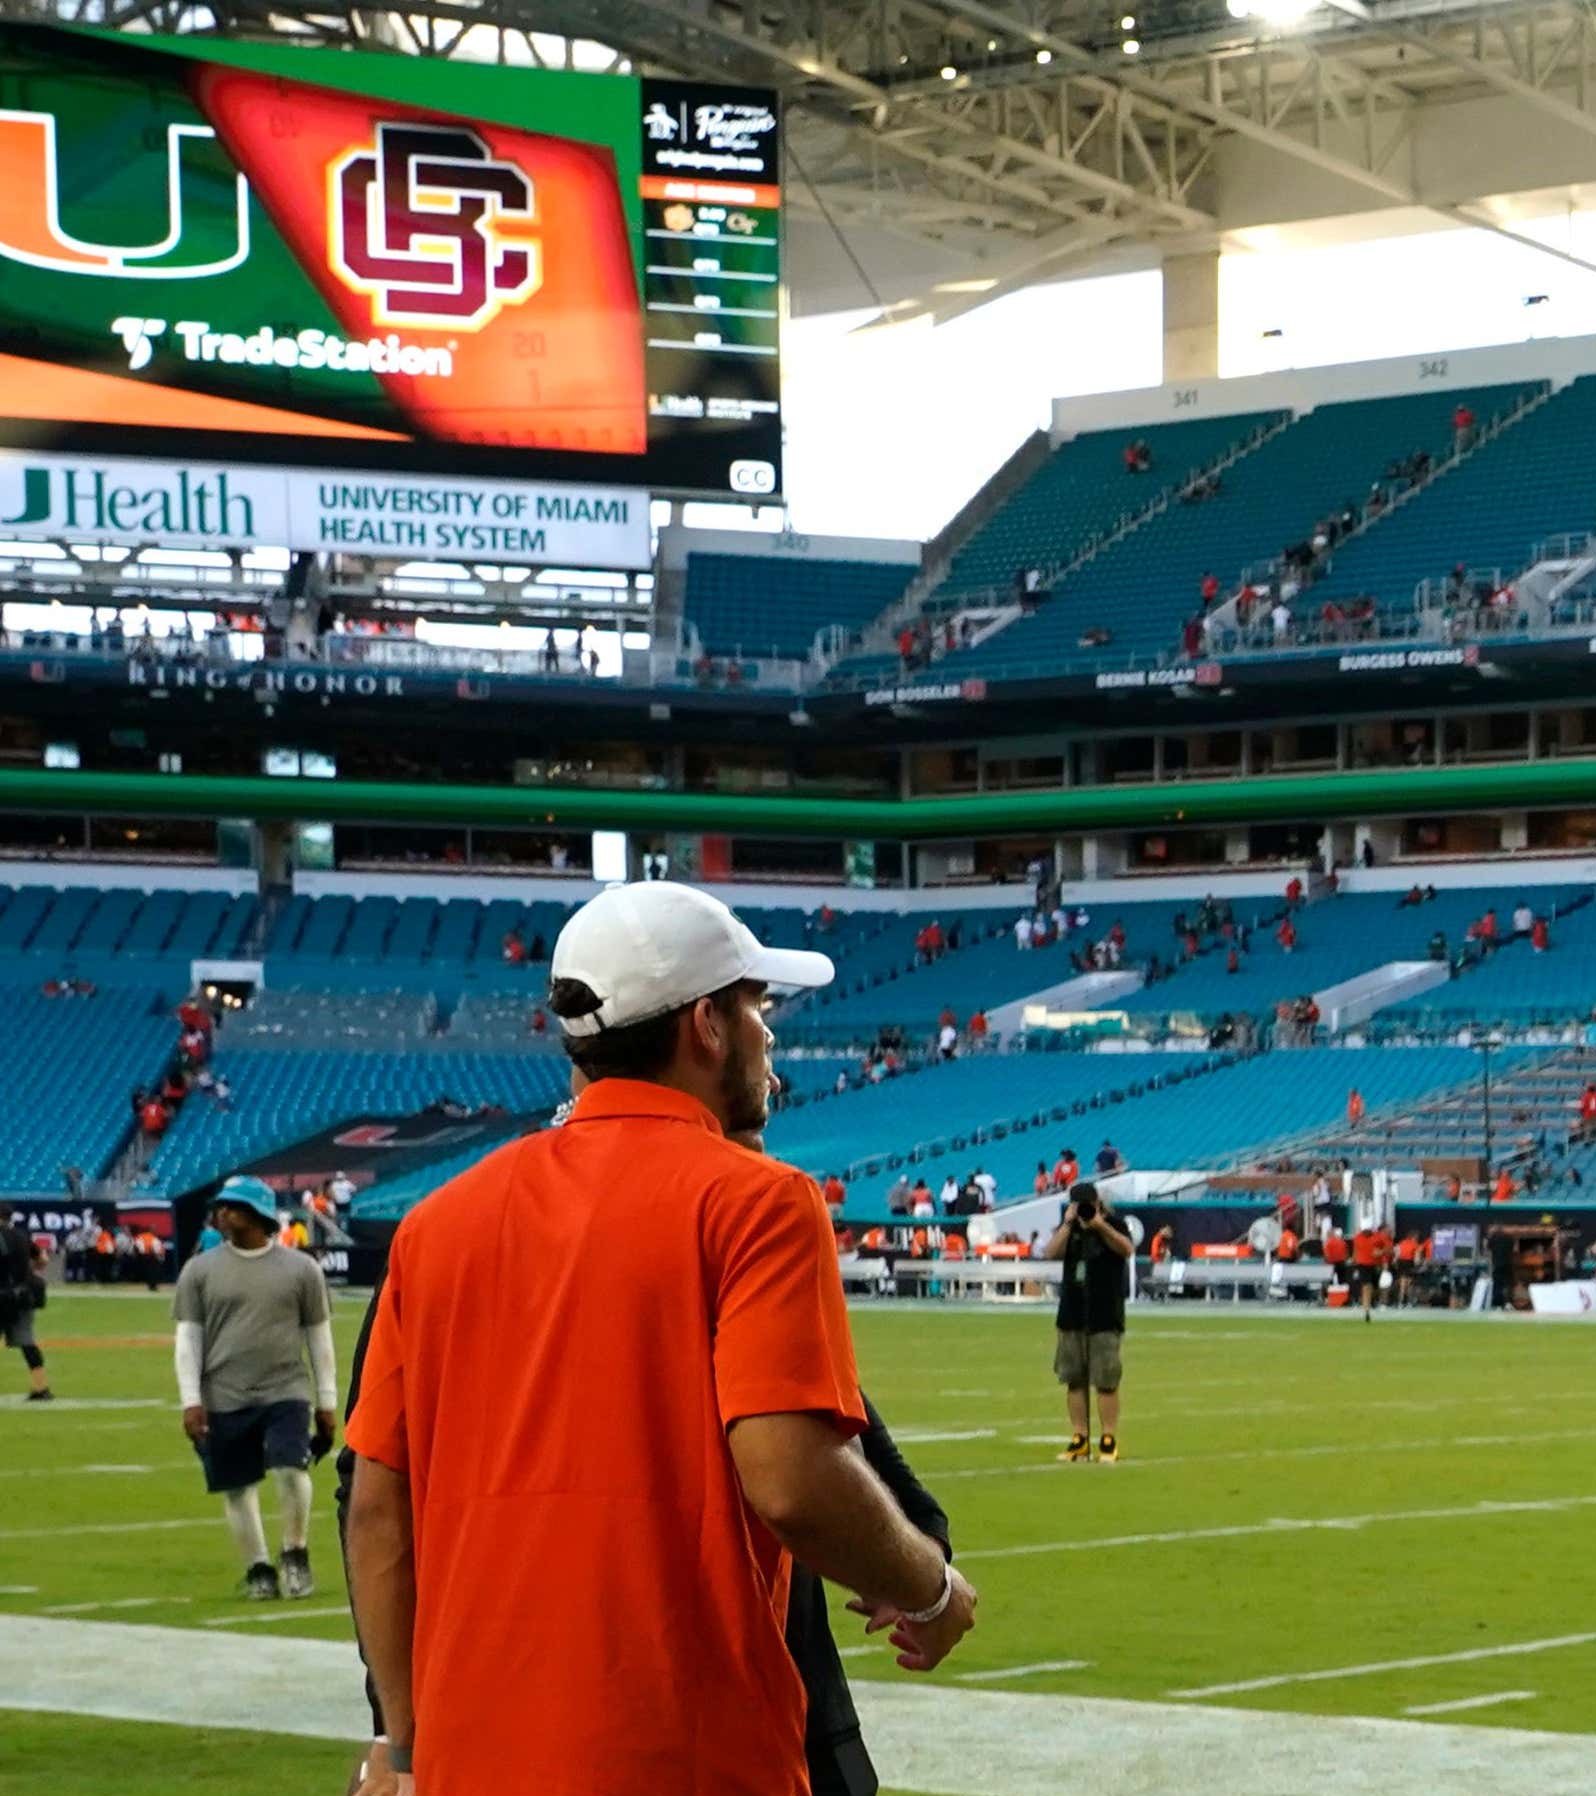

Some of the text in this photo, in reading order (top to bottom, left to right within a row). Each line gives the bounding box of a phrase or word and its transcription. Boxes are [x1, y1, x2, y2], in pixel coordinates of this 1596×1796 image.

[174, 321, 453, 377] TradeStation
[1420, 359, 1448, 379] 342
[1174, 390, 1199, 409] 341
[319, 484, 629, 524] UNIVERSITY OF MIAMI
[320, 518, 546, 552] HEALTH SYSTEM
[129, 660, 226, 689] RING
[266, 671, 403, 695] HONOR
